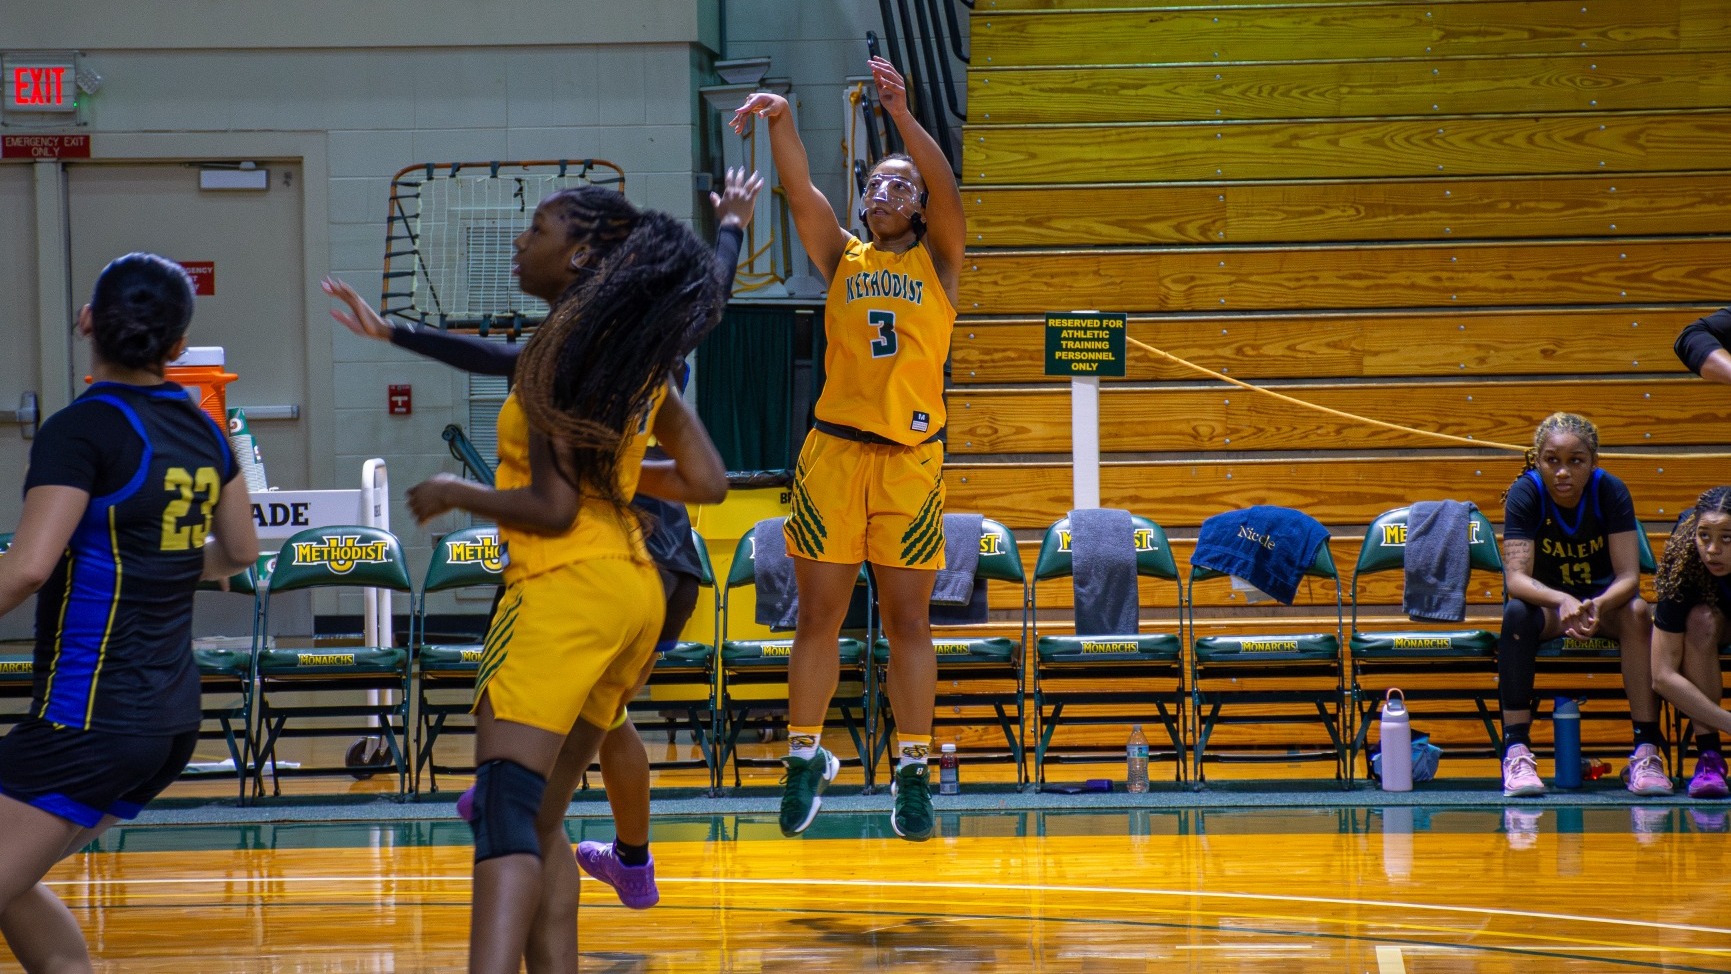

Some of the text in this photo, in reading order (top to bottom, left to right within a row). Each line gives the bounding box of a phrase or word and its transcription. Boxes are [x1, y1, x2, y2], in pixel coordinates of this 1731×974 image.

[14, 67, 65, 105] EXIT
[5, 136, 84, 146] EMERGENCY EXIT
[31, 147, 60, 157] ONLY
[1048, 318, 1124, 329] RESERVED FOR
[867, 309, 899, 359] 3
[1061, 329, 1110, 339] ATHLETIC
[1060, 340, 1110, 350] TRAINING
[1055, 351, 1116, 361] PERSONNEL
[1071, 362, 1099, 371] ONLY
[160, 466, 220, 551] 23
[295, 540, 390, 564] METHODIST
[1541, 536, 1604, 559] SALEM
[1559, 561, 1592, 586] 13
[1082, 641, 1138, 653] MONARCHS
[1241, 640, 1297, 652] MONARCHS
[1393, 637, 1449, 650] MONARCHS
[300, 653, 354, 666] MONARCHS
